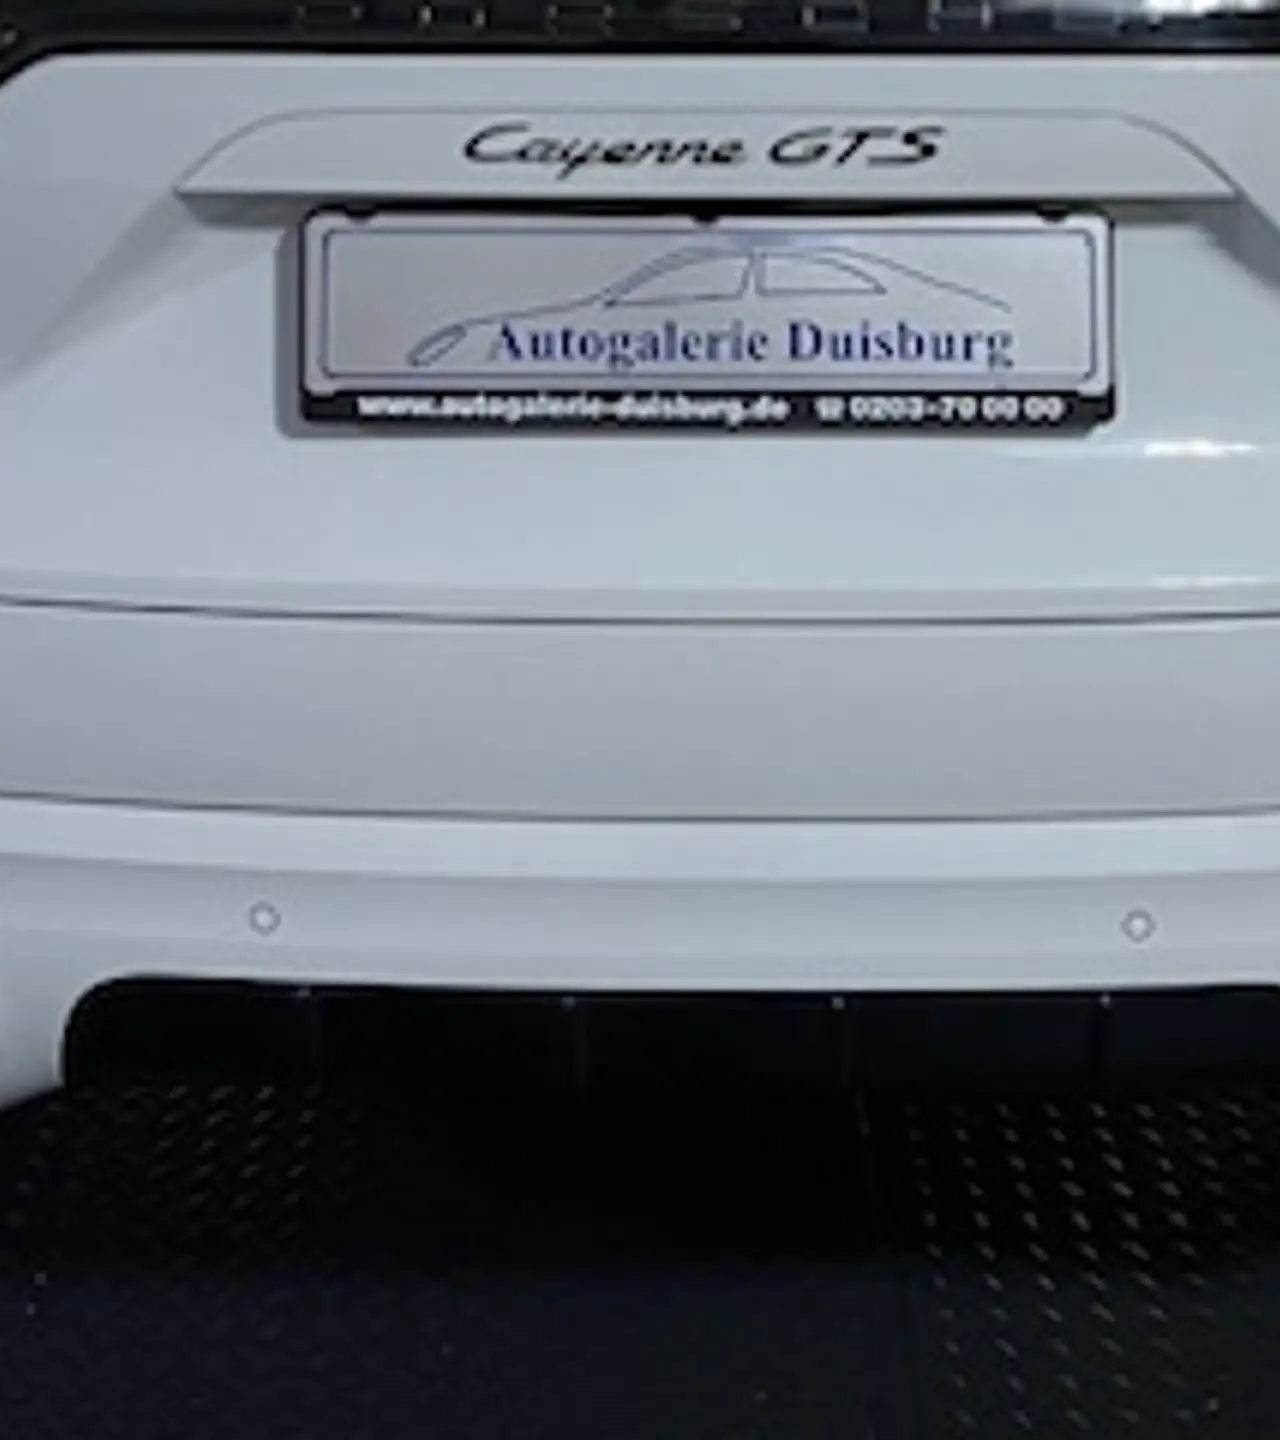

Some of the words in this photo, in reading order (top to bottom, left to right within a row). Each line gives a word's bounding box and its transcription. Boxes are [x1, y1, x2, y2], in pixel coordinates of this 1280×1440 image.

[463, 122, 746, 179] Cayenne
[768, 124, 946, 167] GTS
[487, 318, 768, 372] Autogalerie
[787, 318, 1015, 372] Duisburg
